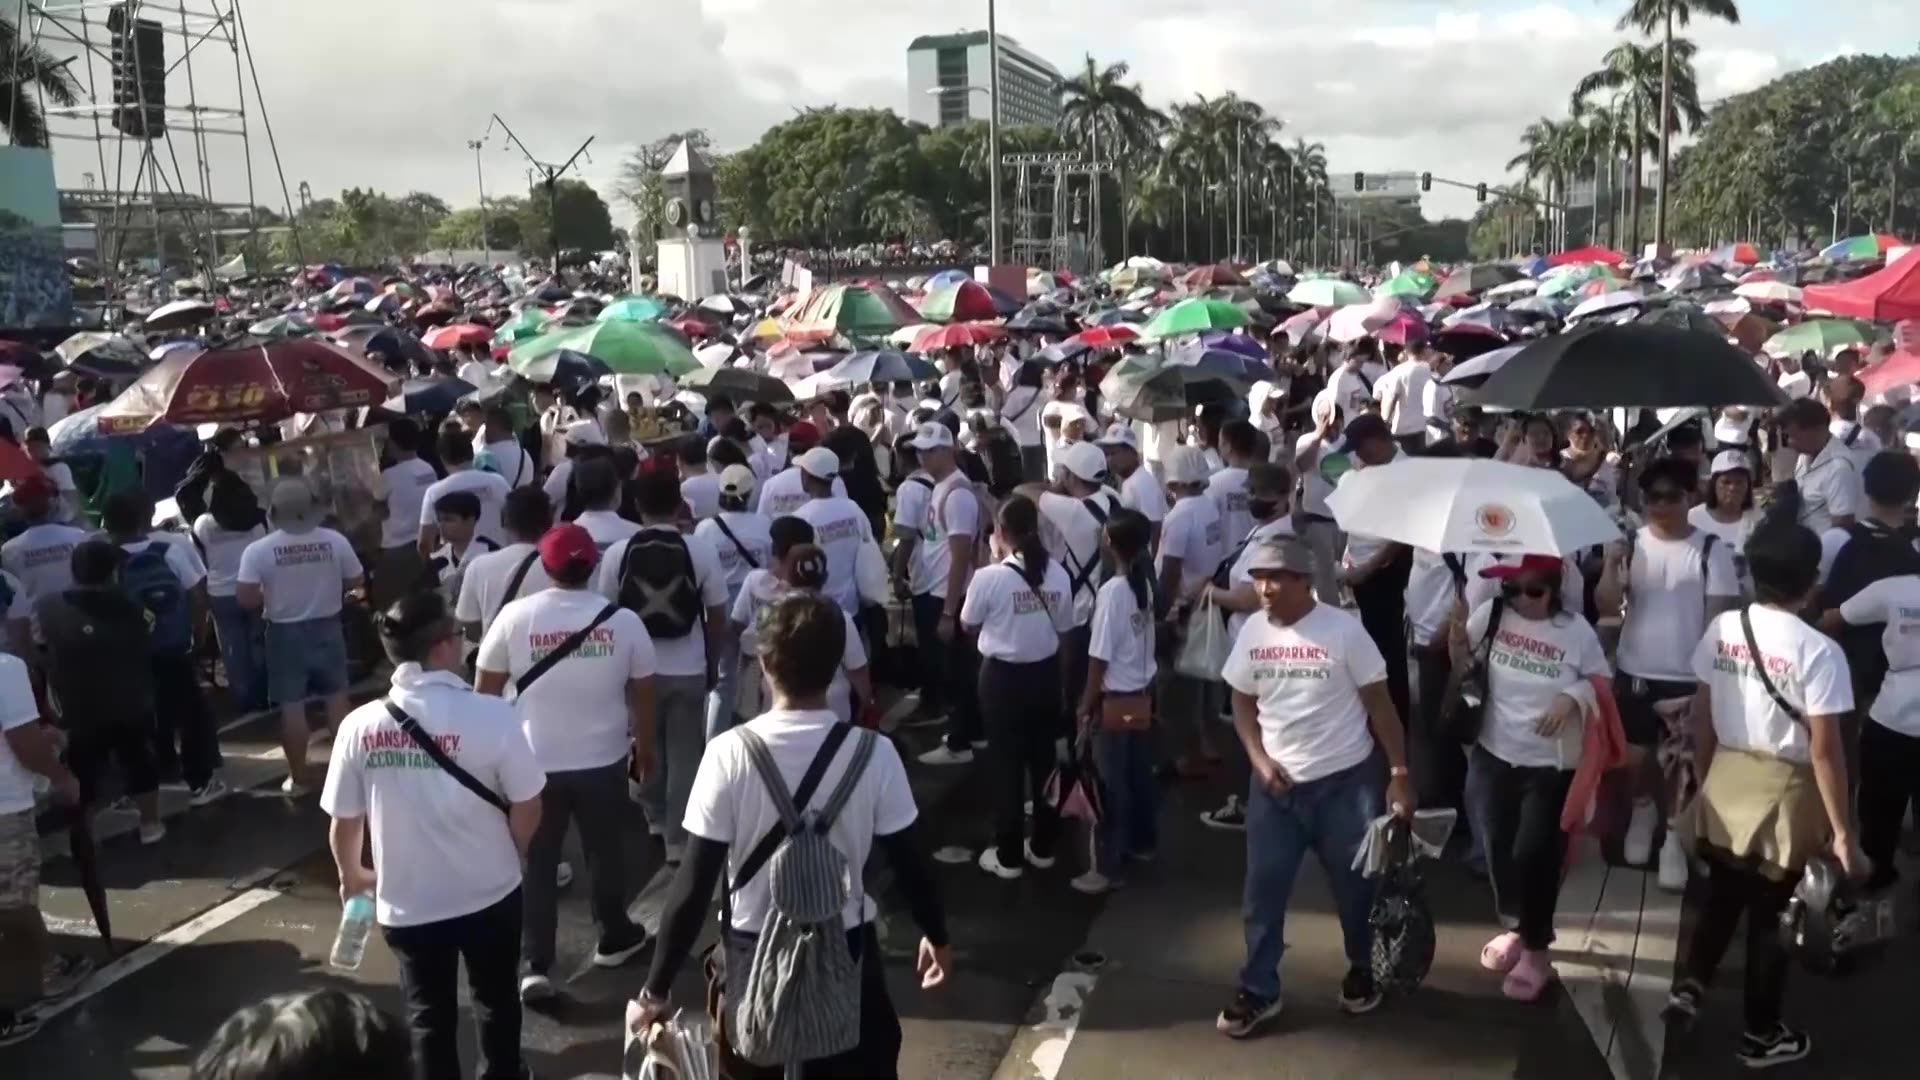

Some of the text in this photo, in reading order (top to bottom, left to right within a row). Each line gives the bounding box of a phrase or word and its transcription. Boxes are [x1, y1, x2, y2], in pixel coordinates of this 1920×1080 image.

[529, 628, 615, 648] TRANSPNCY
[1496, 629, 1566, 662] ANSPARENCY
[1249, 646, 1328, 661] TRANSPARENCY
[361, 729, 461, 752] TRANSPANCY.
[365, 750, 458, 770] ACCOUNTAB
